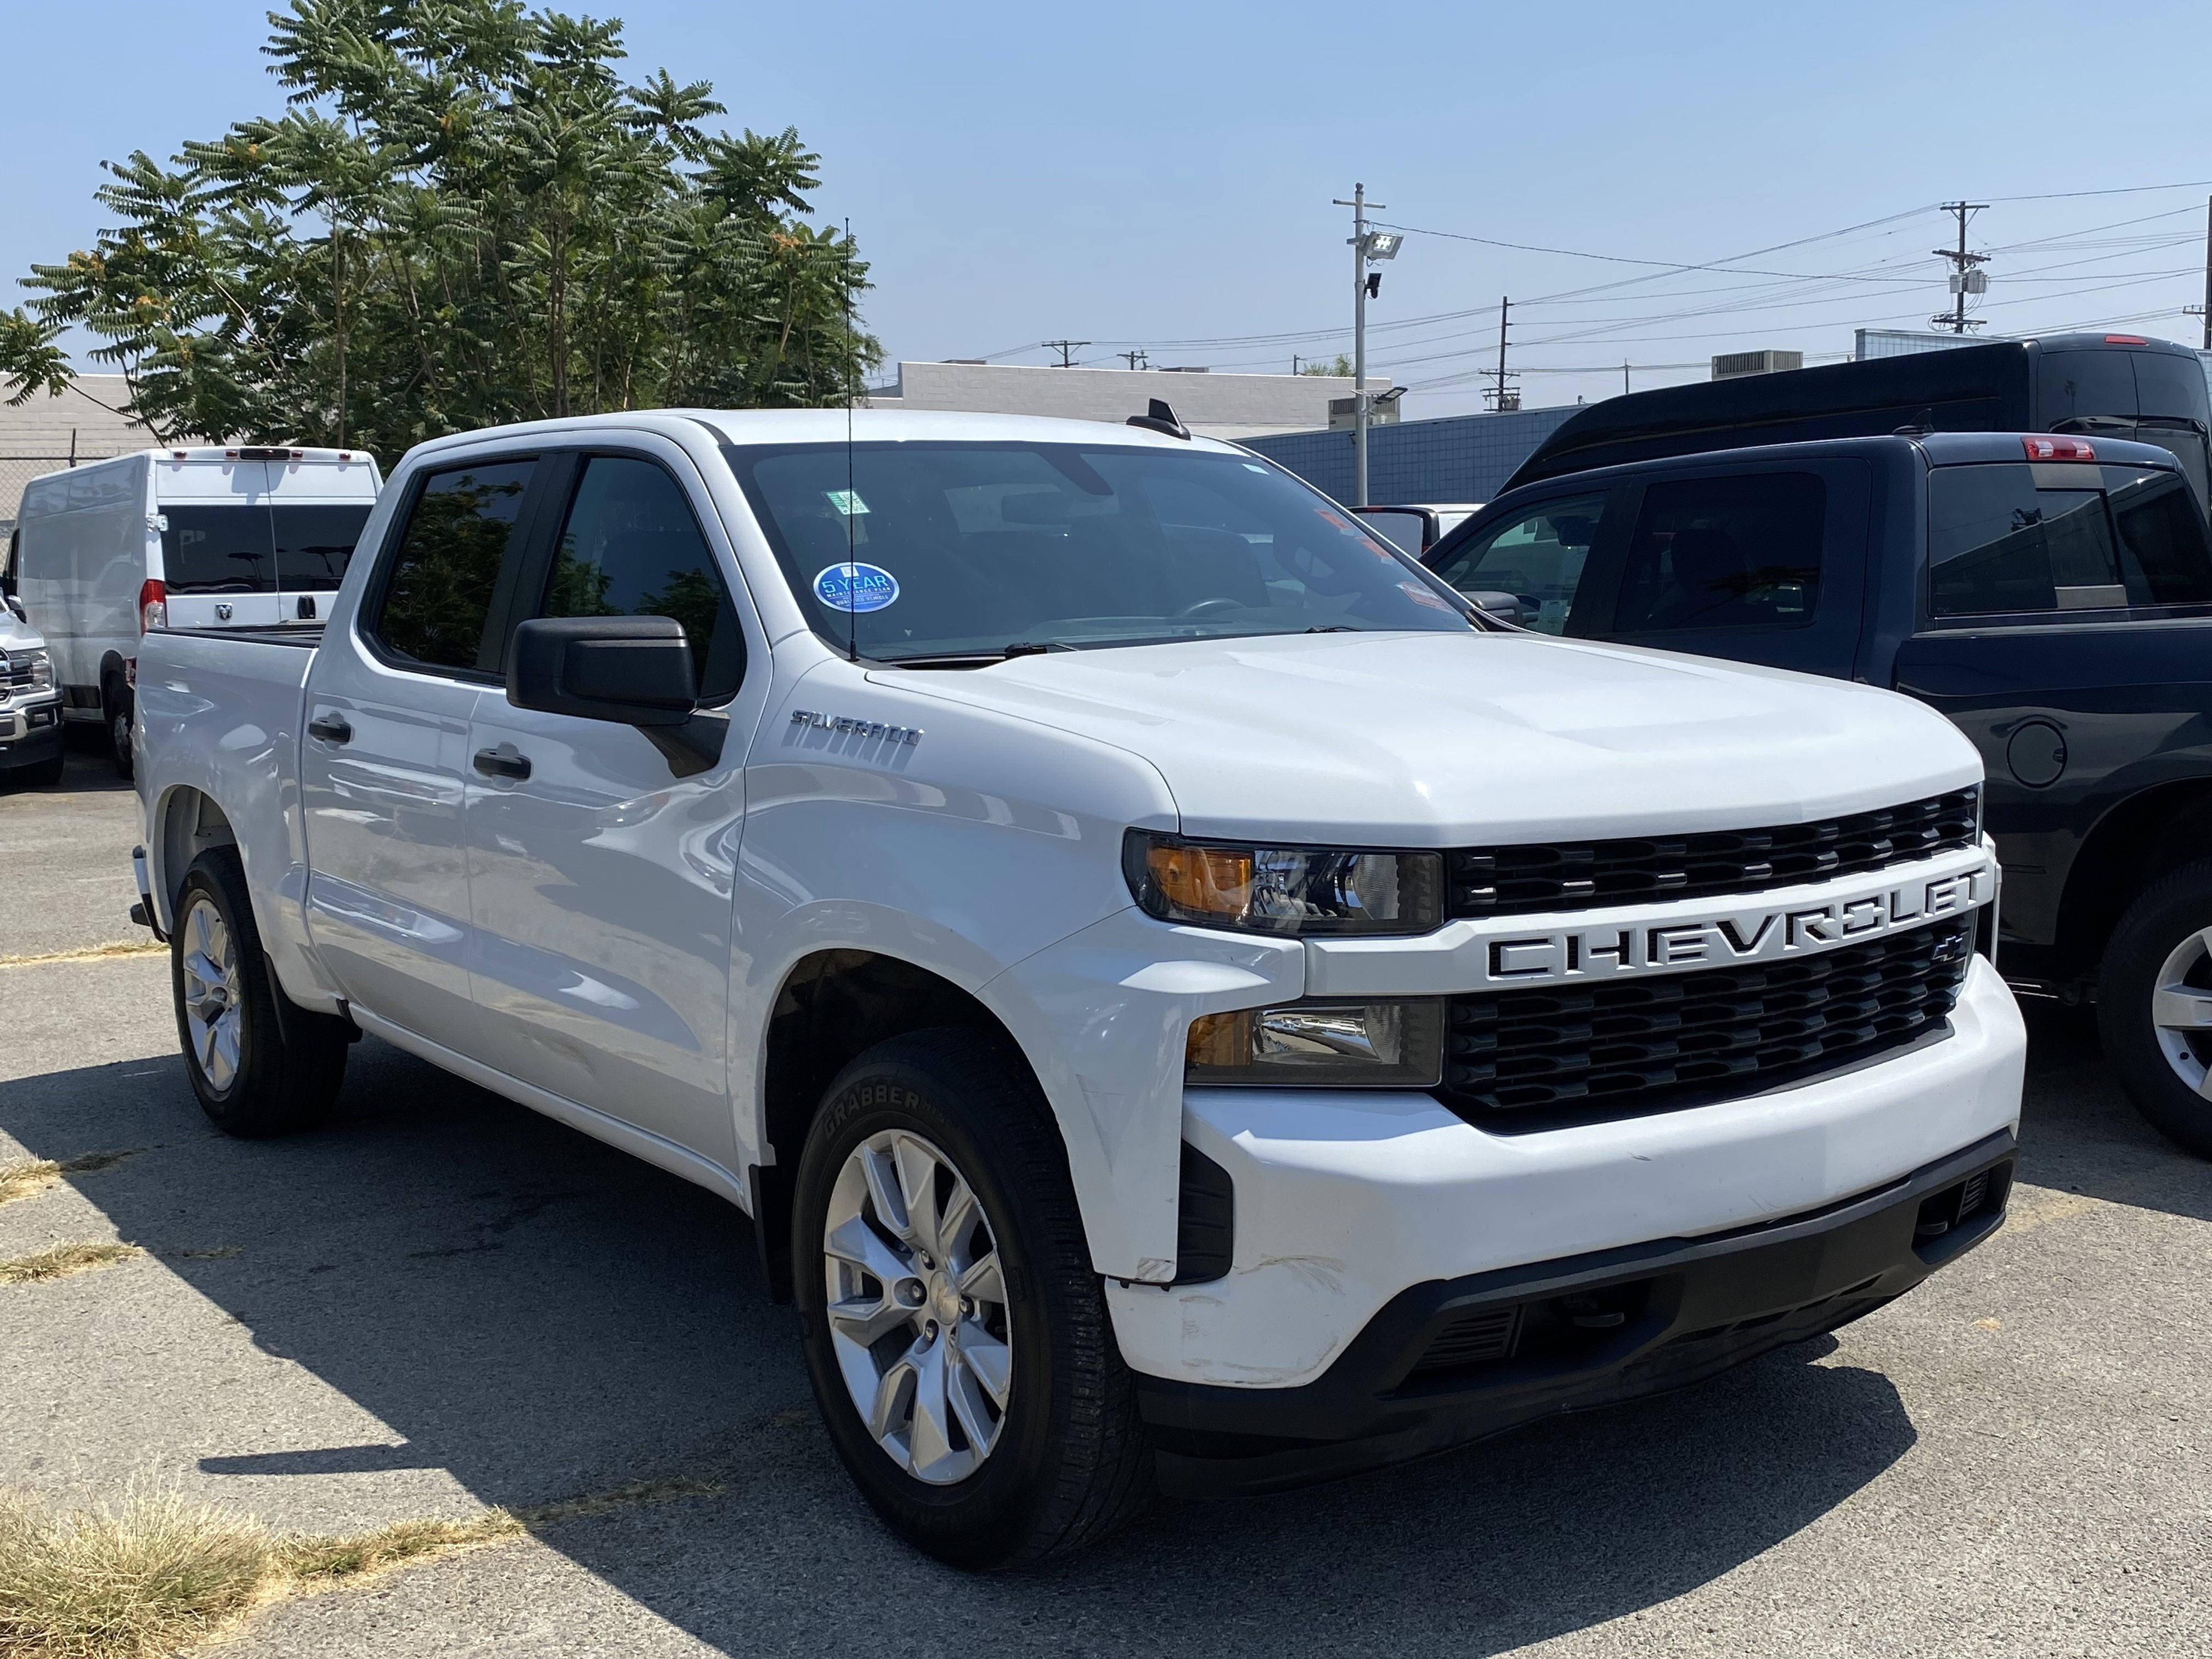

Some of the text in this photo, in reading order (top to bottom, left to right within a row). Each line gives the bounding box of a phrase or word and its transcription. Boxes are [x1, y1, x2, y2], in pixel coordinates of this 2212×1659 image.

[821, 575, 889, 593] 5 YEAR
[827, 588, 871, 598] MAINTEANCE
[790, 709, 924, 746] SILVERADO
[1487, 865, 1988, 982] CHEVROLET
[823, 1084, 921, 1138] GRABBER
